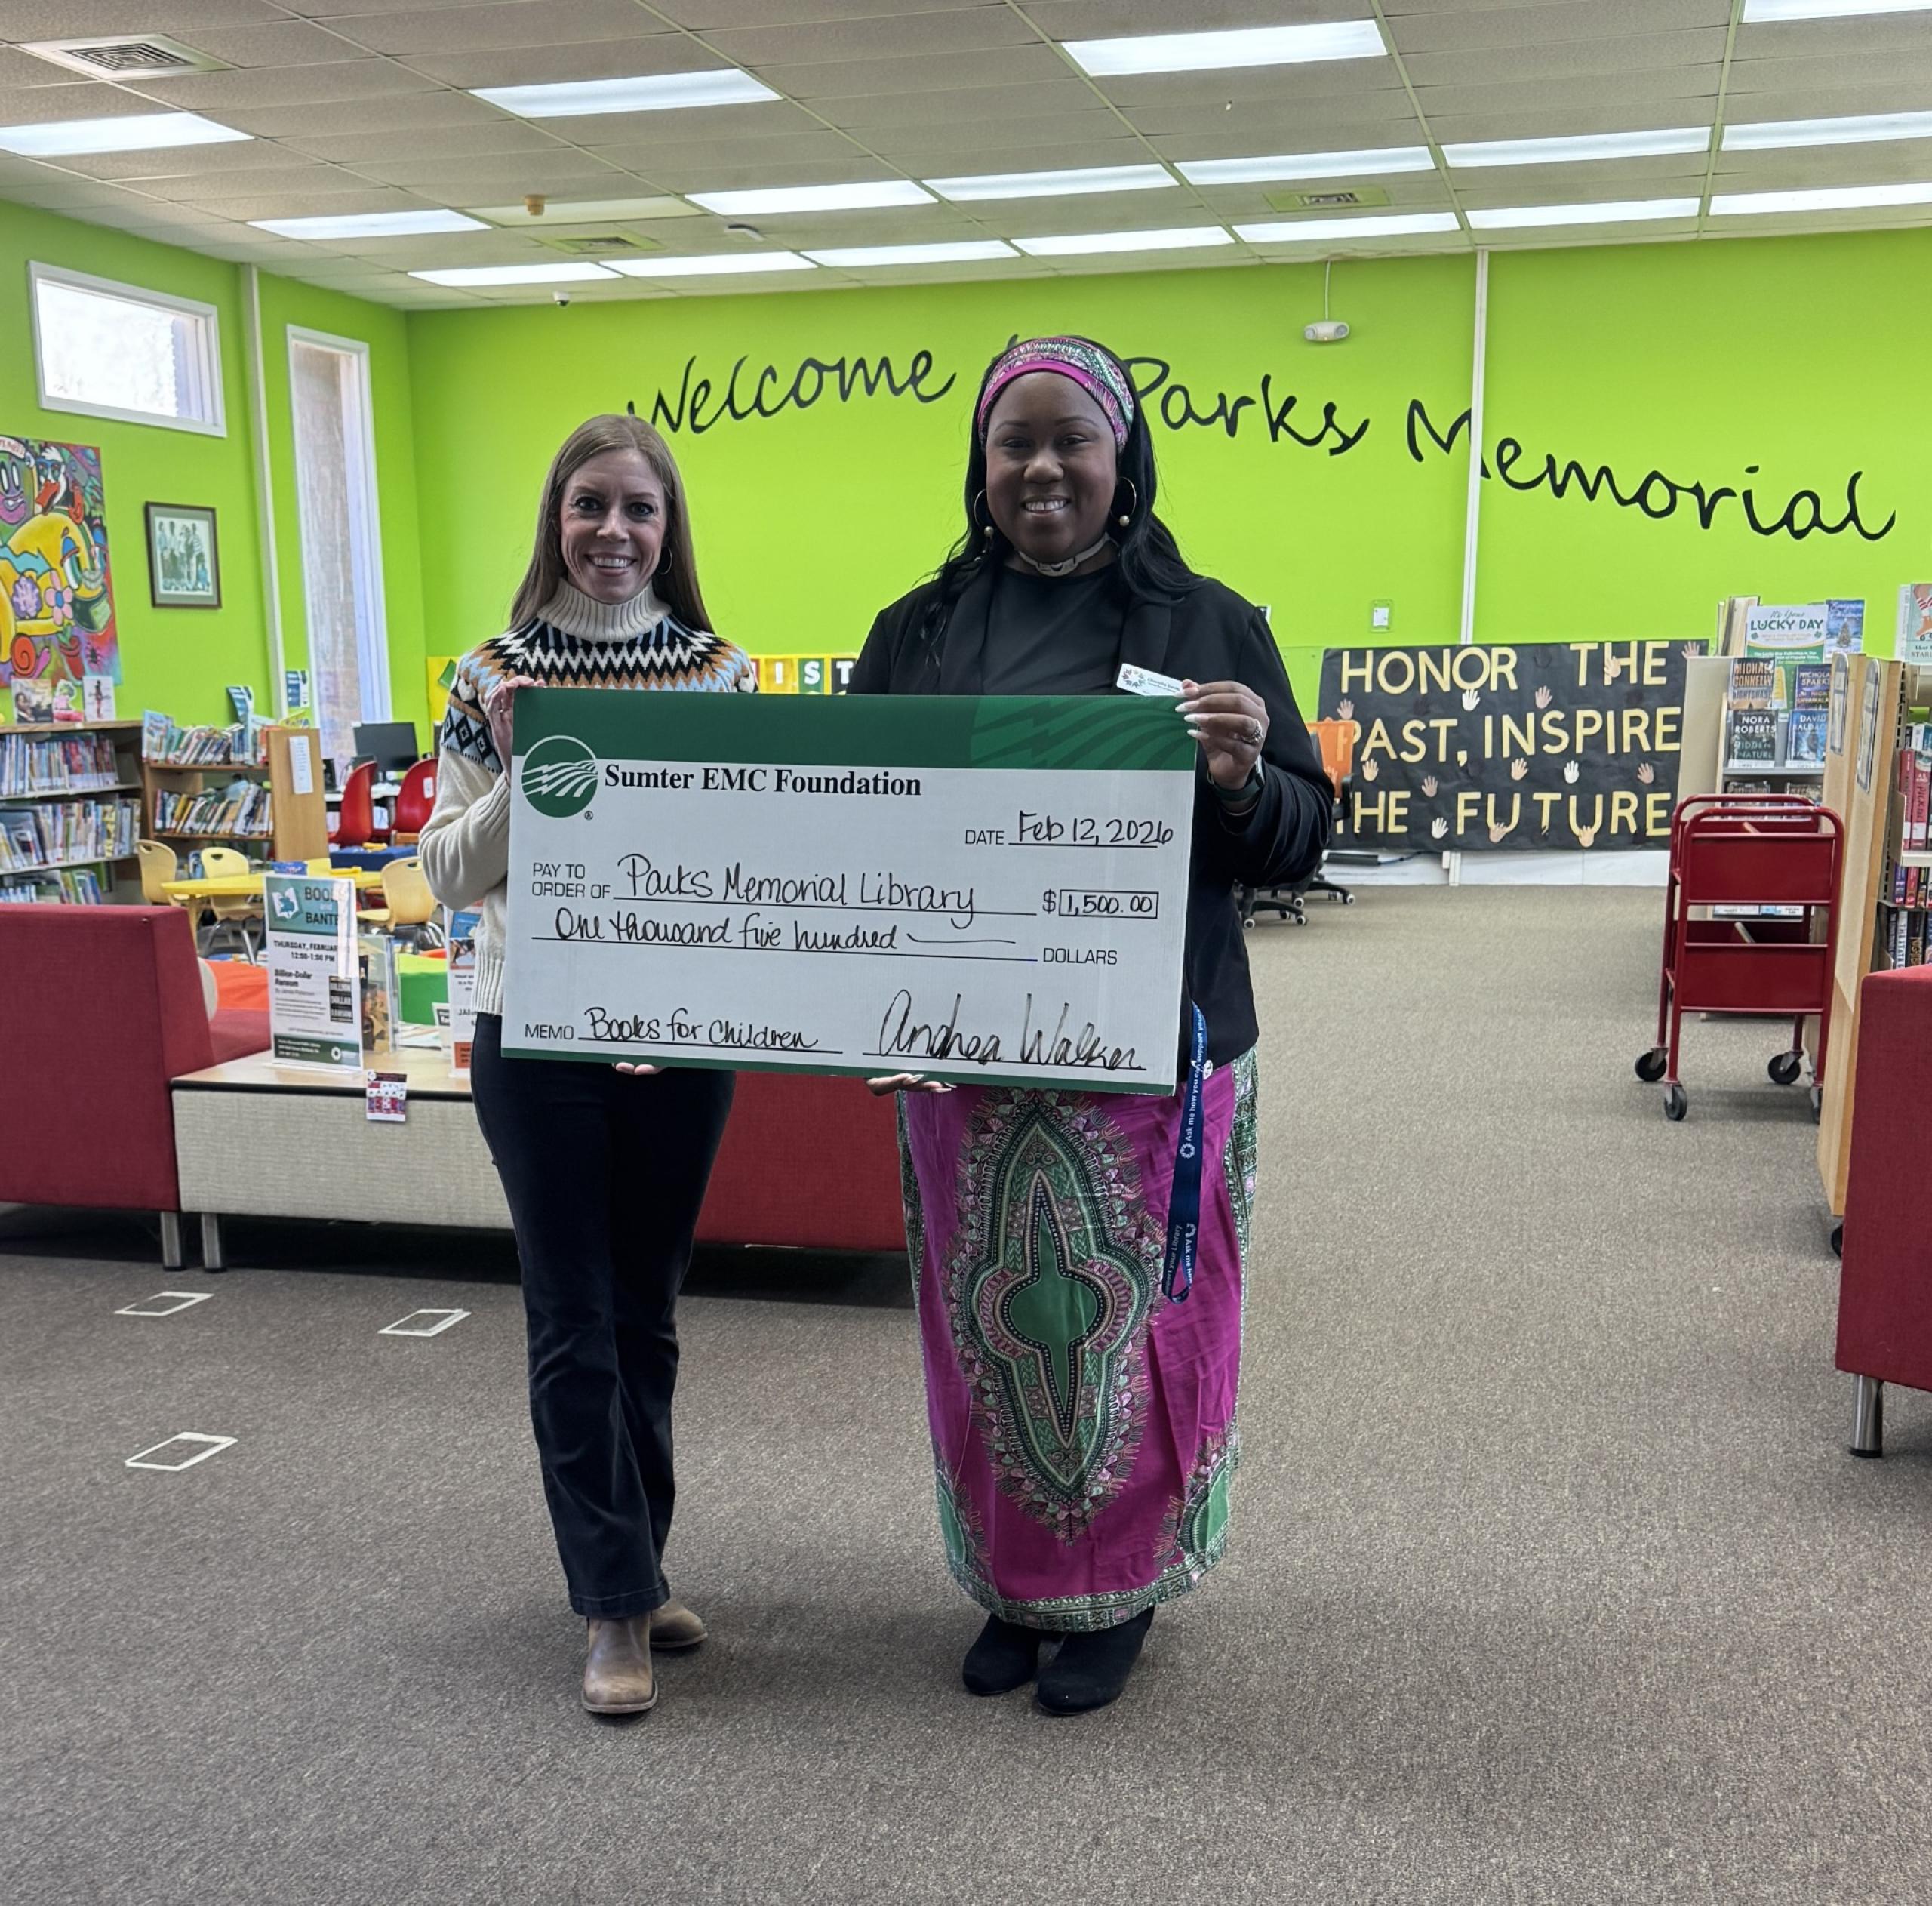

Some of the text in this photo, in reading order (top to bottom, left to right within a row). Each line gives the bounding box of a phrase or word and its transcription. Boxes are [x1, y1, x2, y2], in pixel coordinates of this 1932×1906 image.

[627, 349, 957, 434] Welcome
[1406, 399, 1896, 540] Memorial
[1750, 619, 1824, 631] LUCKY DAY
[1341, 640, 1670, 694] HONOR THE
[1735, 725, 1777, 734] ROBERTS
[1741, 716, 1770, 725] NORA
[1337, 707, 1682, 767] PAST, INSPIRE
[604, 765, 921, 796] Sumter EMC Foundation
[1457, 791, 1672, 837] FUTURE
[965, 810, 1174, 845] DATE Feb 12, 2026
[533, 862, 586, 879] PAY TO
[531, 882, 586, 898] ORDER
[591, 884, 611, 899] OF
[617, 854, 713, 898] Parks
[723, 862, 847, 904] Memorial
[860, 872, 974, 929] Library
[306, 912, 338, 926] BANTE
[555, 907, 897, 950] One thousand five hundred
[310, 943, 338, 952] FEBRUA
[1043, 947, 1118, 965] DOLLARS
[525, 1007, 819, 1048] MEMO Books for Children
[1189, 1095, 1198, 1112] how
[1188, 1113, 1195, 1125] me
[1185, 1126, 1193, 1142] Ask
[1171, 1224, 1183, 1252] Library
[1186, 1255, 1192, 1267] me
